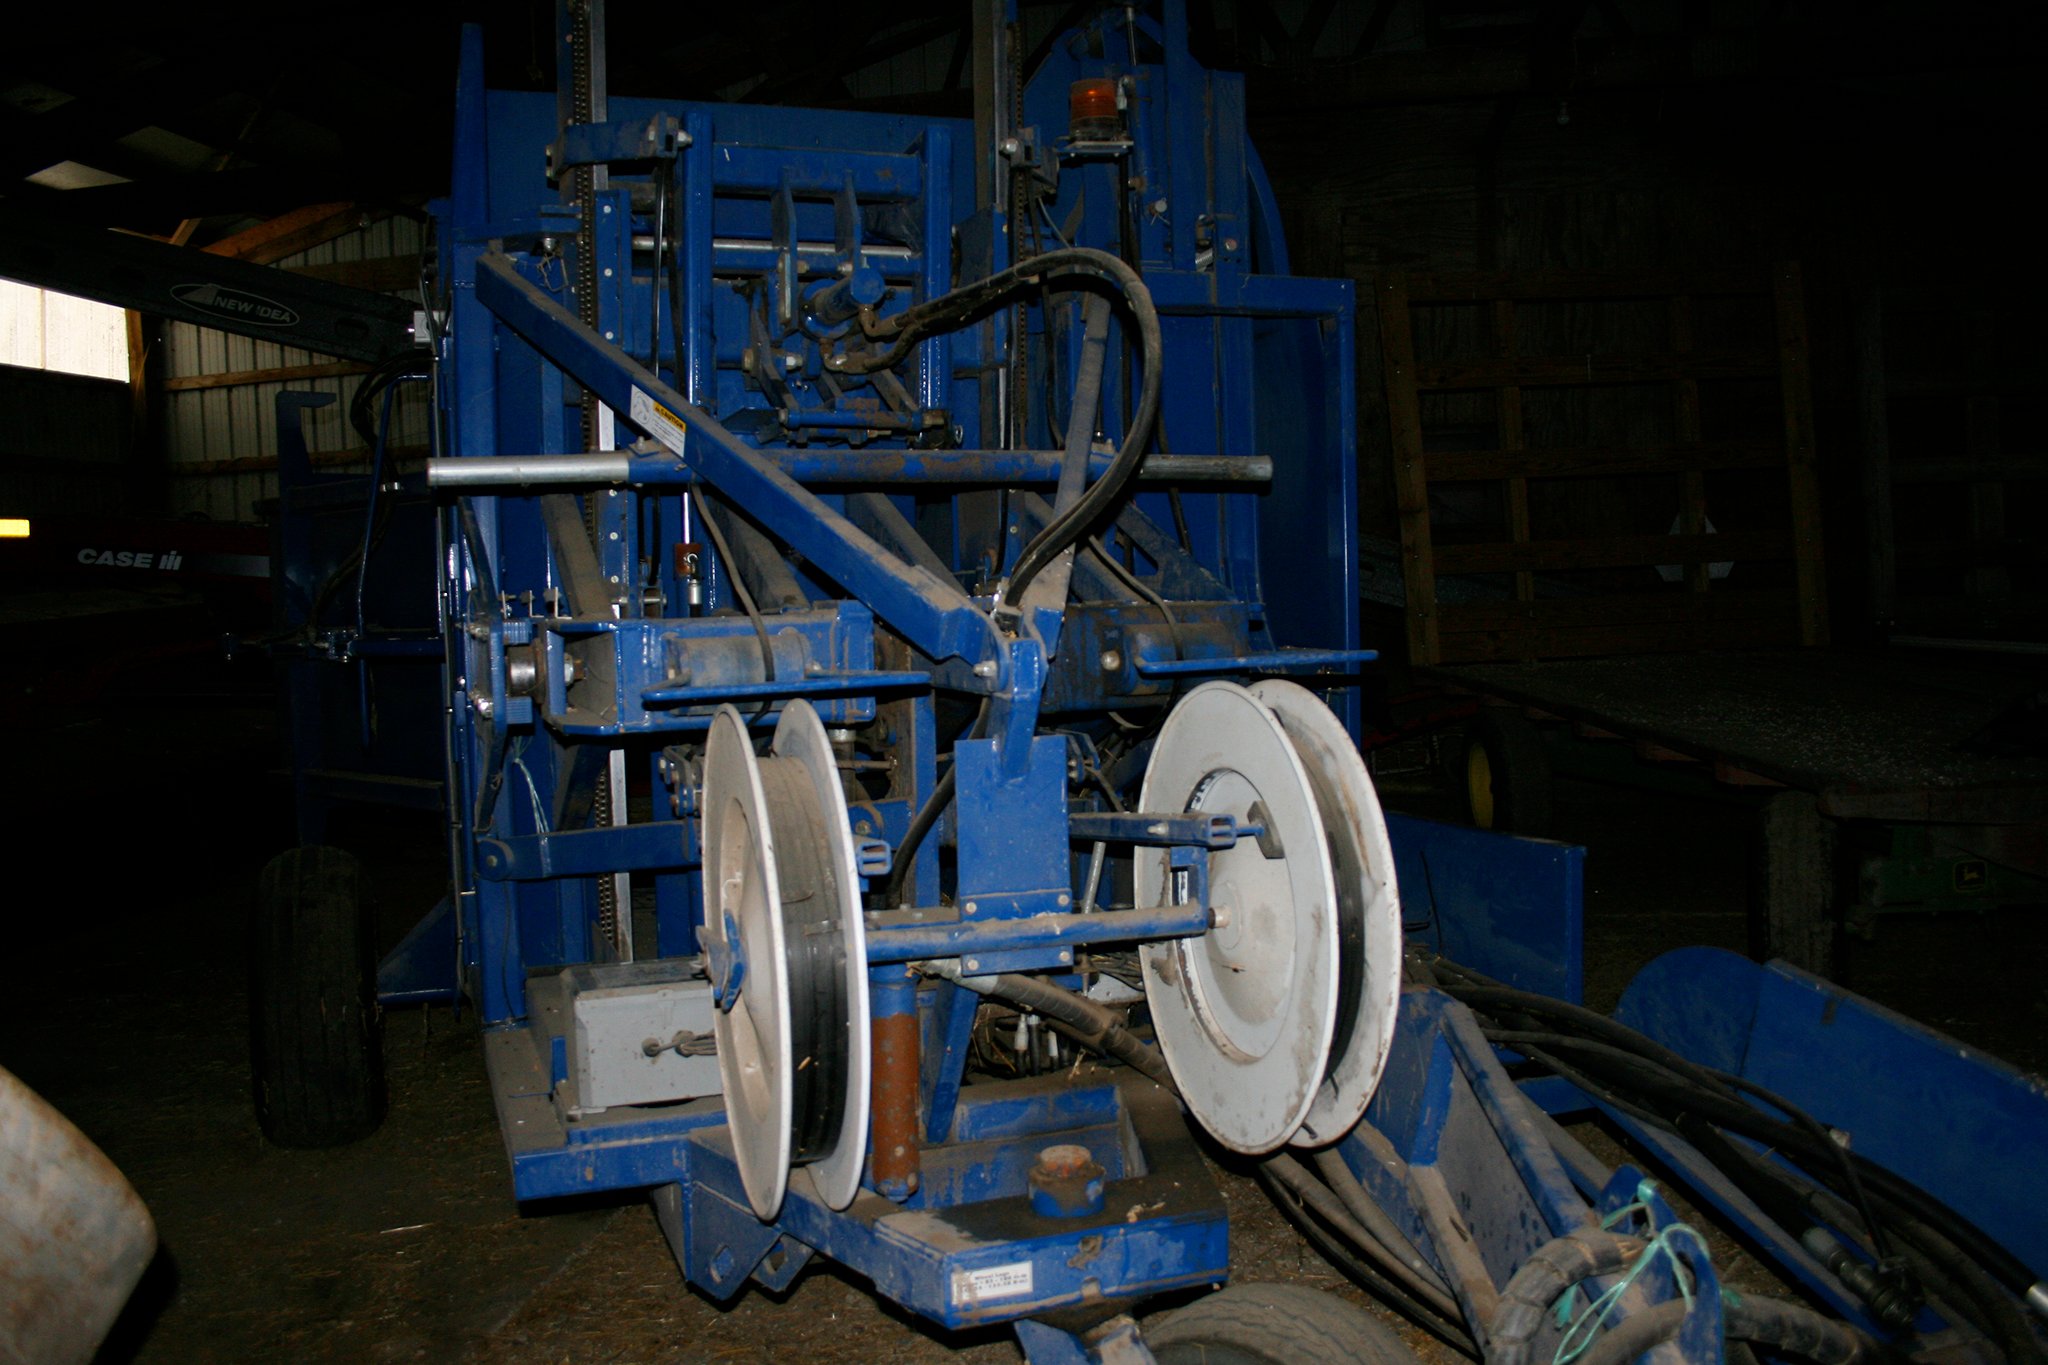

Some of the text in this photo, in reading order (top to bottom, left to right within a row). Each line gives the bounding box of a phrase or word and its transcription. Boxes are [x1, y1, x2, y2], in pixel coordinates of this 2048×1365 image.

[213, 296, 291, 323] NEW IDEA
[76, 548, 154, 568] CASE
